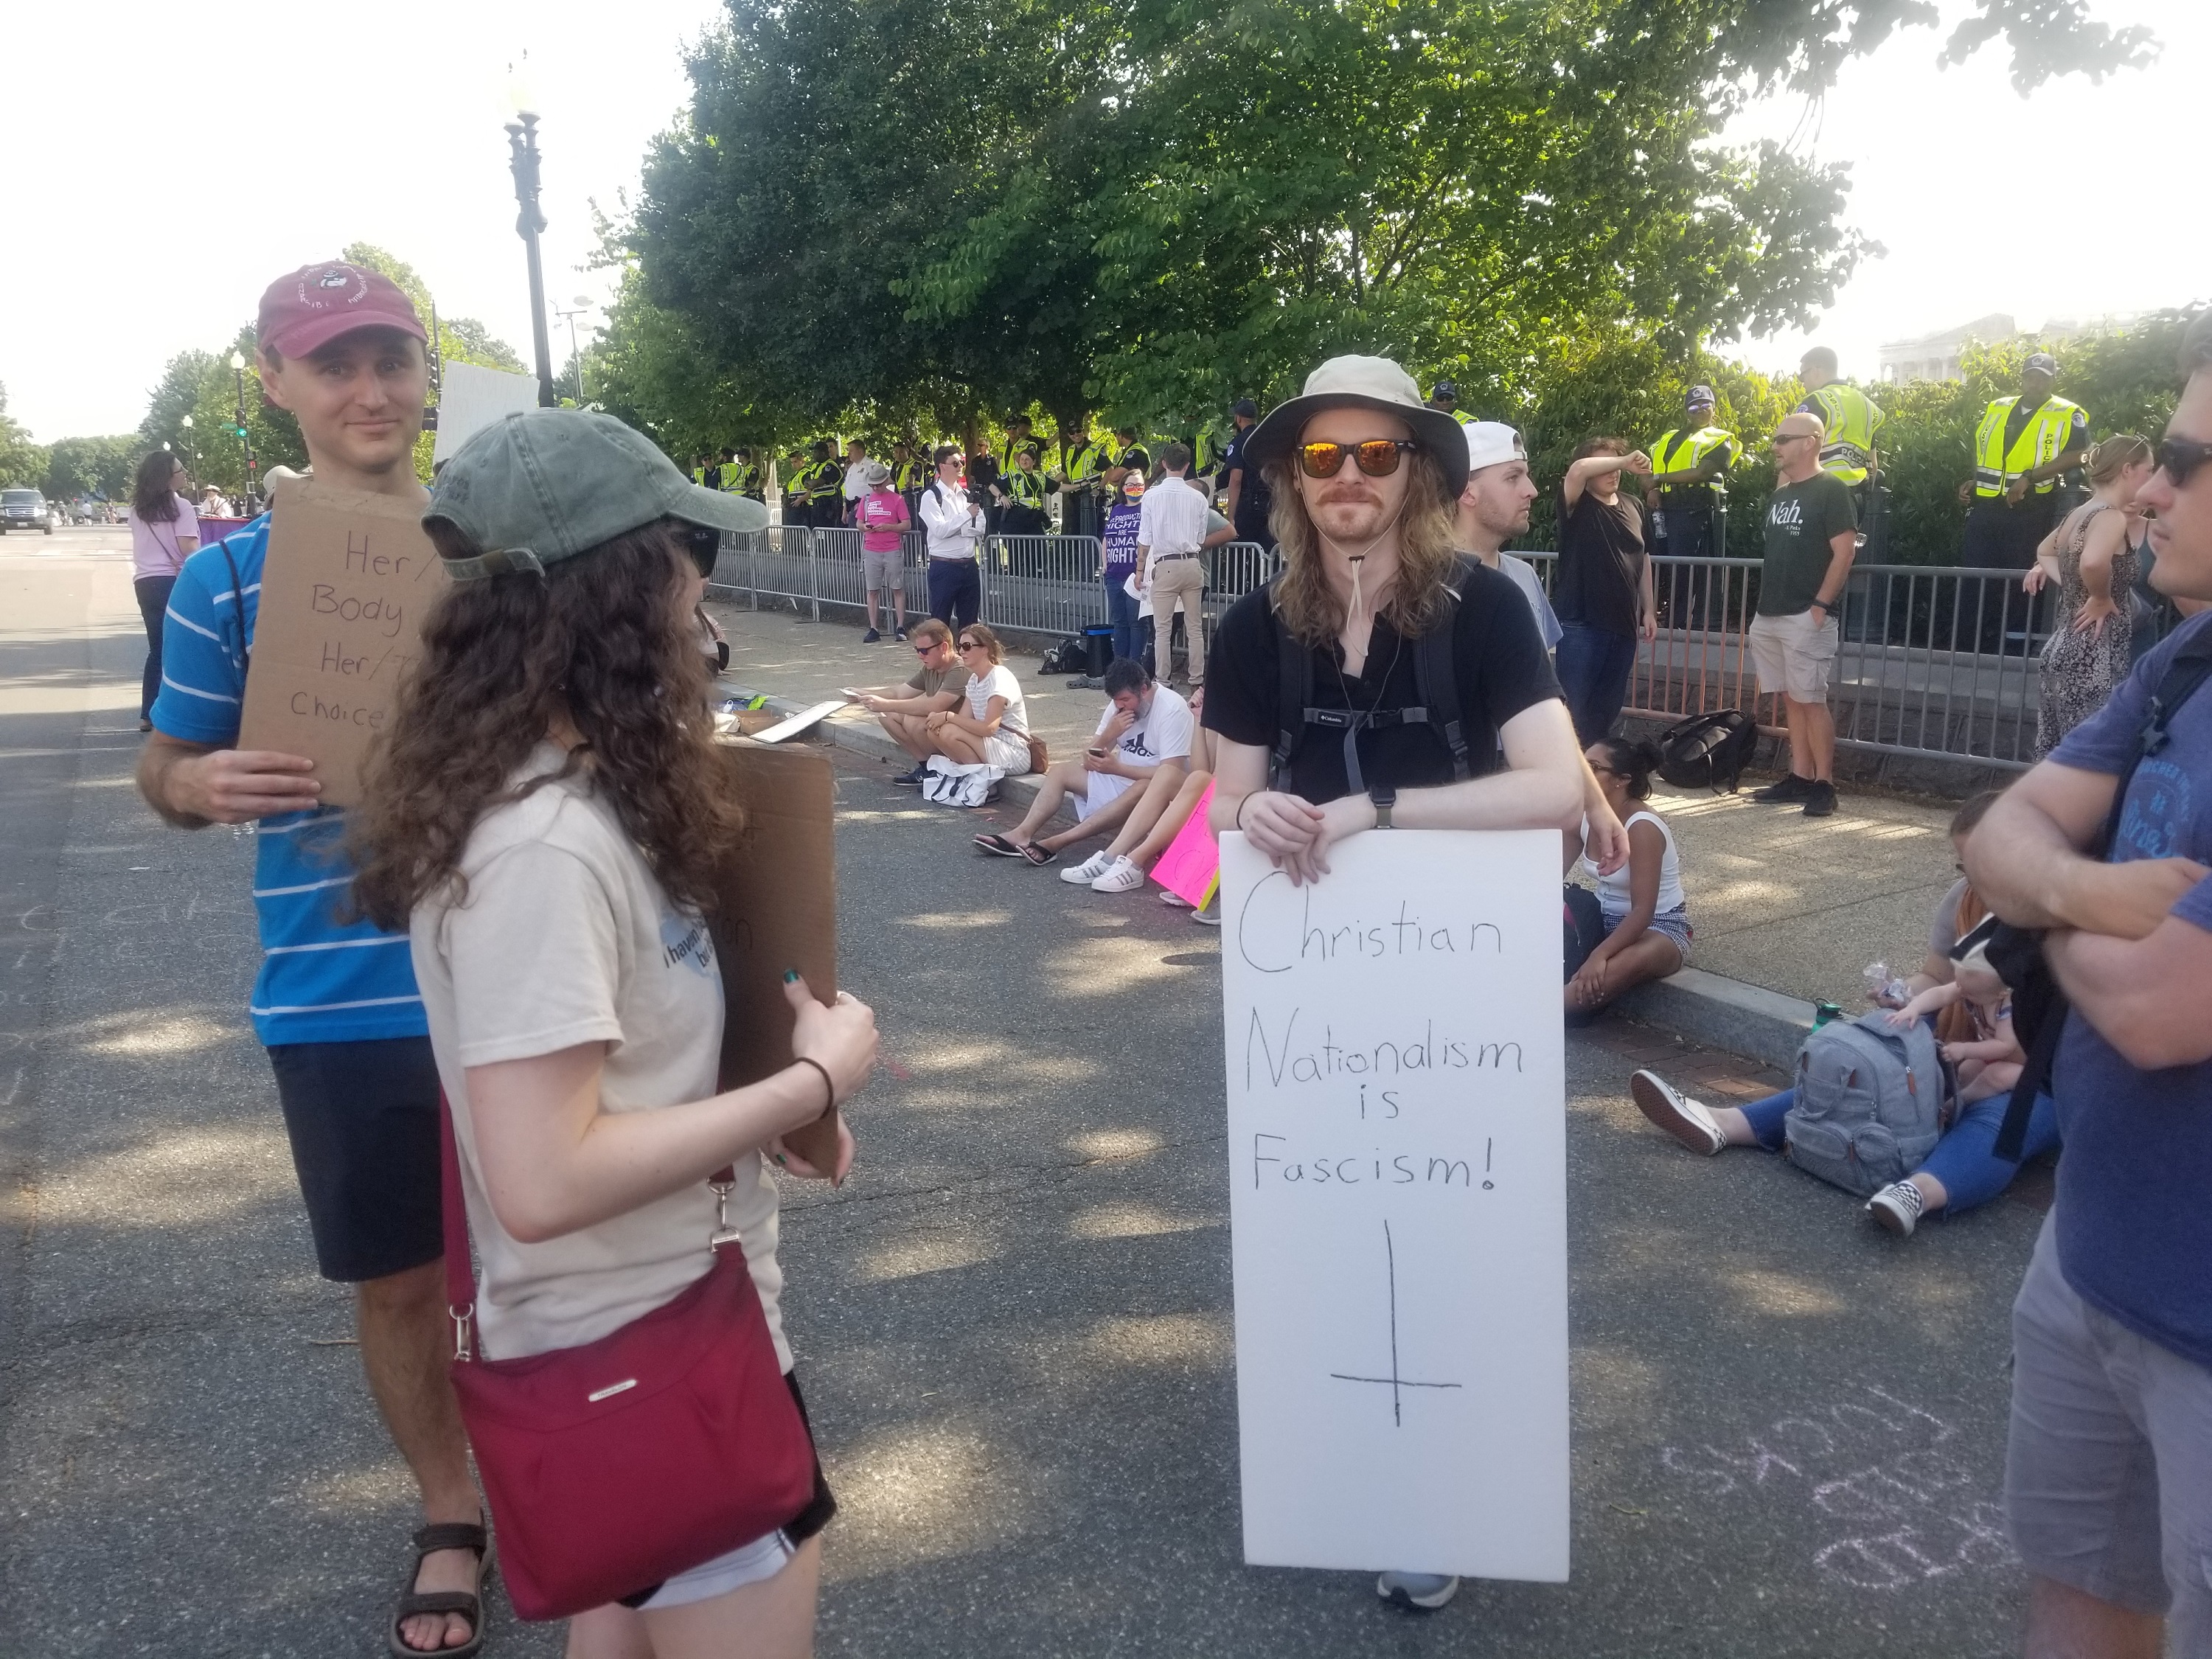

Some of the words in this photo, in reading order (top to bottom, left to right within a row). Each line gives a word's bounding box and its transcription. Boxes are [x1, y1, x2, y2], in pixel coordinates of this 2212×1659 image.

[1765, 498, 1804, 528] Nah.
[311, 583, 403, 638] Body
[291, 691, 385, 729] Choice
[1239, 870, 1502, 973] Christian
[1247, 1005, 1523, 1092] Nationalism
[1360, 1083, 1399, 1119] is
[1253, 1133, 1495, 1191] Fascism!
